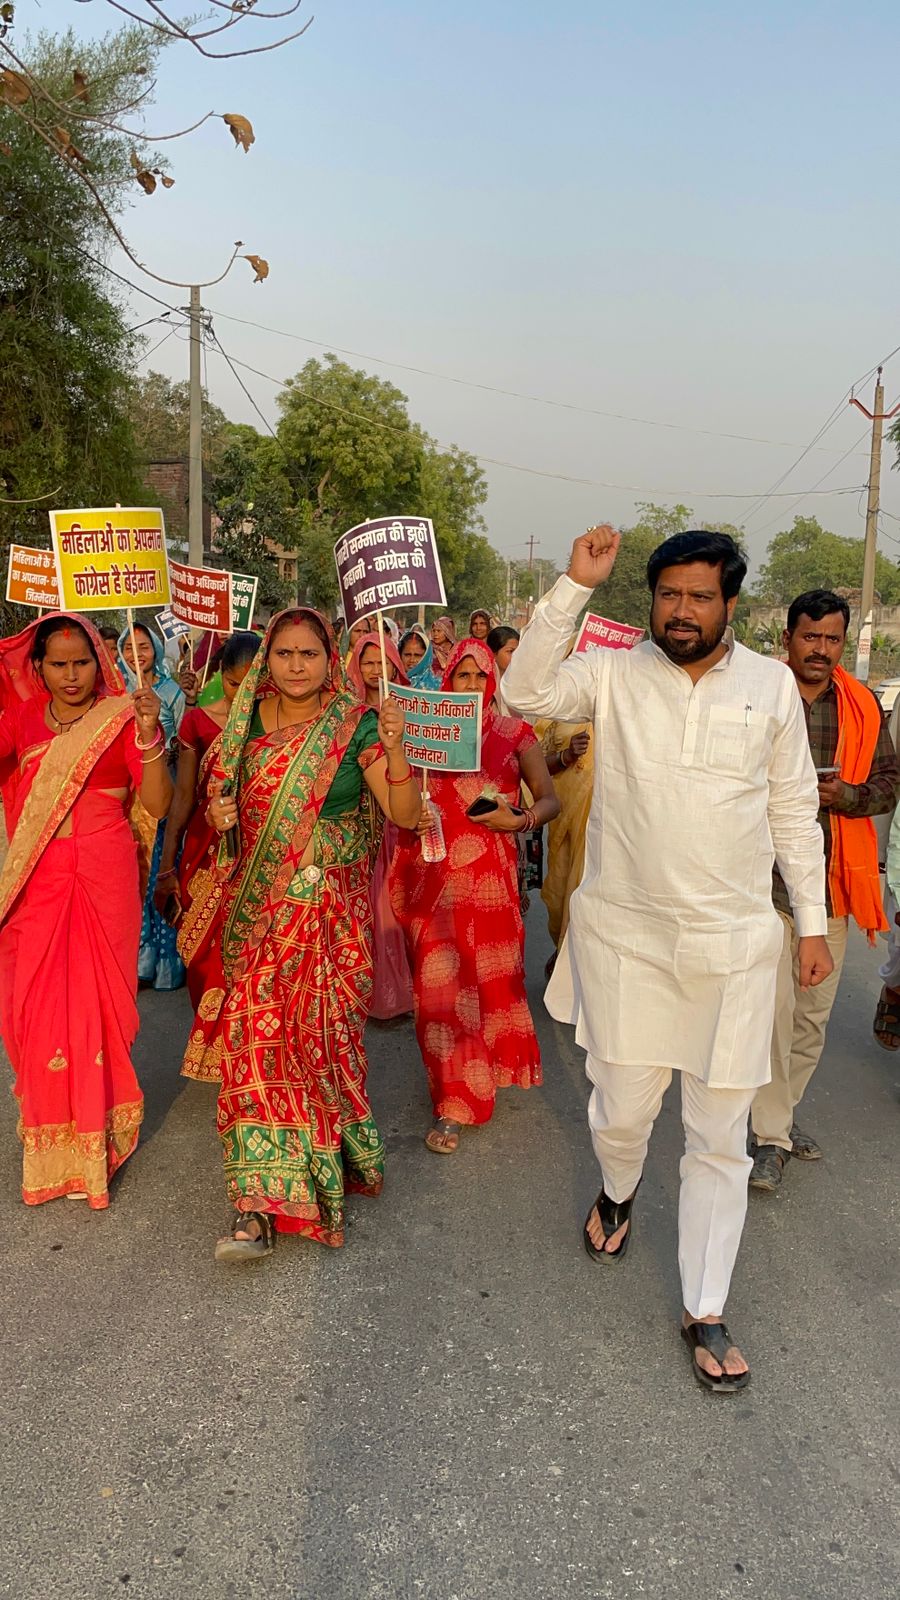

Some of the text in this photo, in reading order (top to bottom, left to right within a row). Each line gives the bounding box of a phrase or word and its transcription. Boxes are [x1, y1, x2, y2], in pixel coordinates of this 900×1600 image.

[60, 522, 164, 555] महिलाओं का अपमान
[336, 521, 429, 567] नारी सम्मान की झूठी
[42, 553, 51, 569] के
[342, 557, 367, 591] कहानी
[373, 548, 410, 573] कांग्रेस
[409, 547, 427, 569] की
[11, 569, 21, 582] का
[73, 565, 111, 597] कांग्रेस
[110, 563, 122, 596] है
[186, 571, 195, 587] के
[195, 575, 229, 592] अधिकारों
[201, 594, 216, 608] आई
[353, 574, 418, 612] आदत पुरानी।
[585, 620, 609, 639] कांग्रेस
[420, 697, 431, 715] के
[432, 699, 477, 718] अधिकारों
[421, 723, 452, 742] कांग्रेस
[452, 724, 461, 742] है
